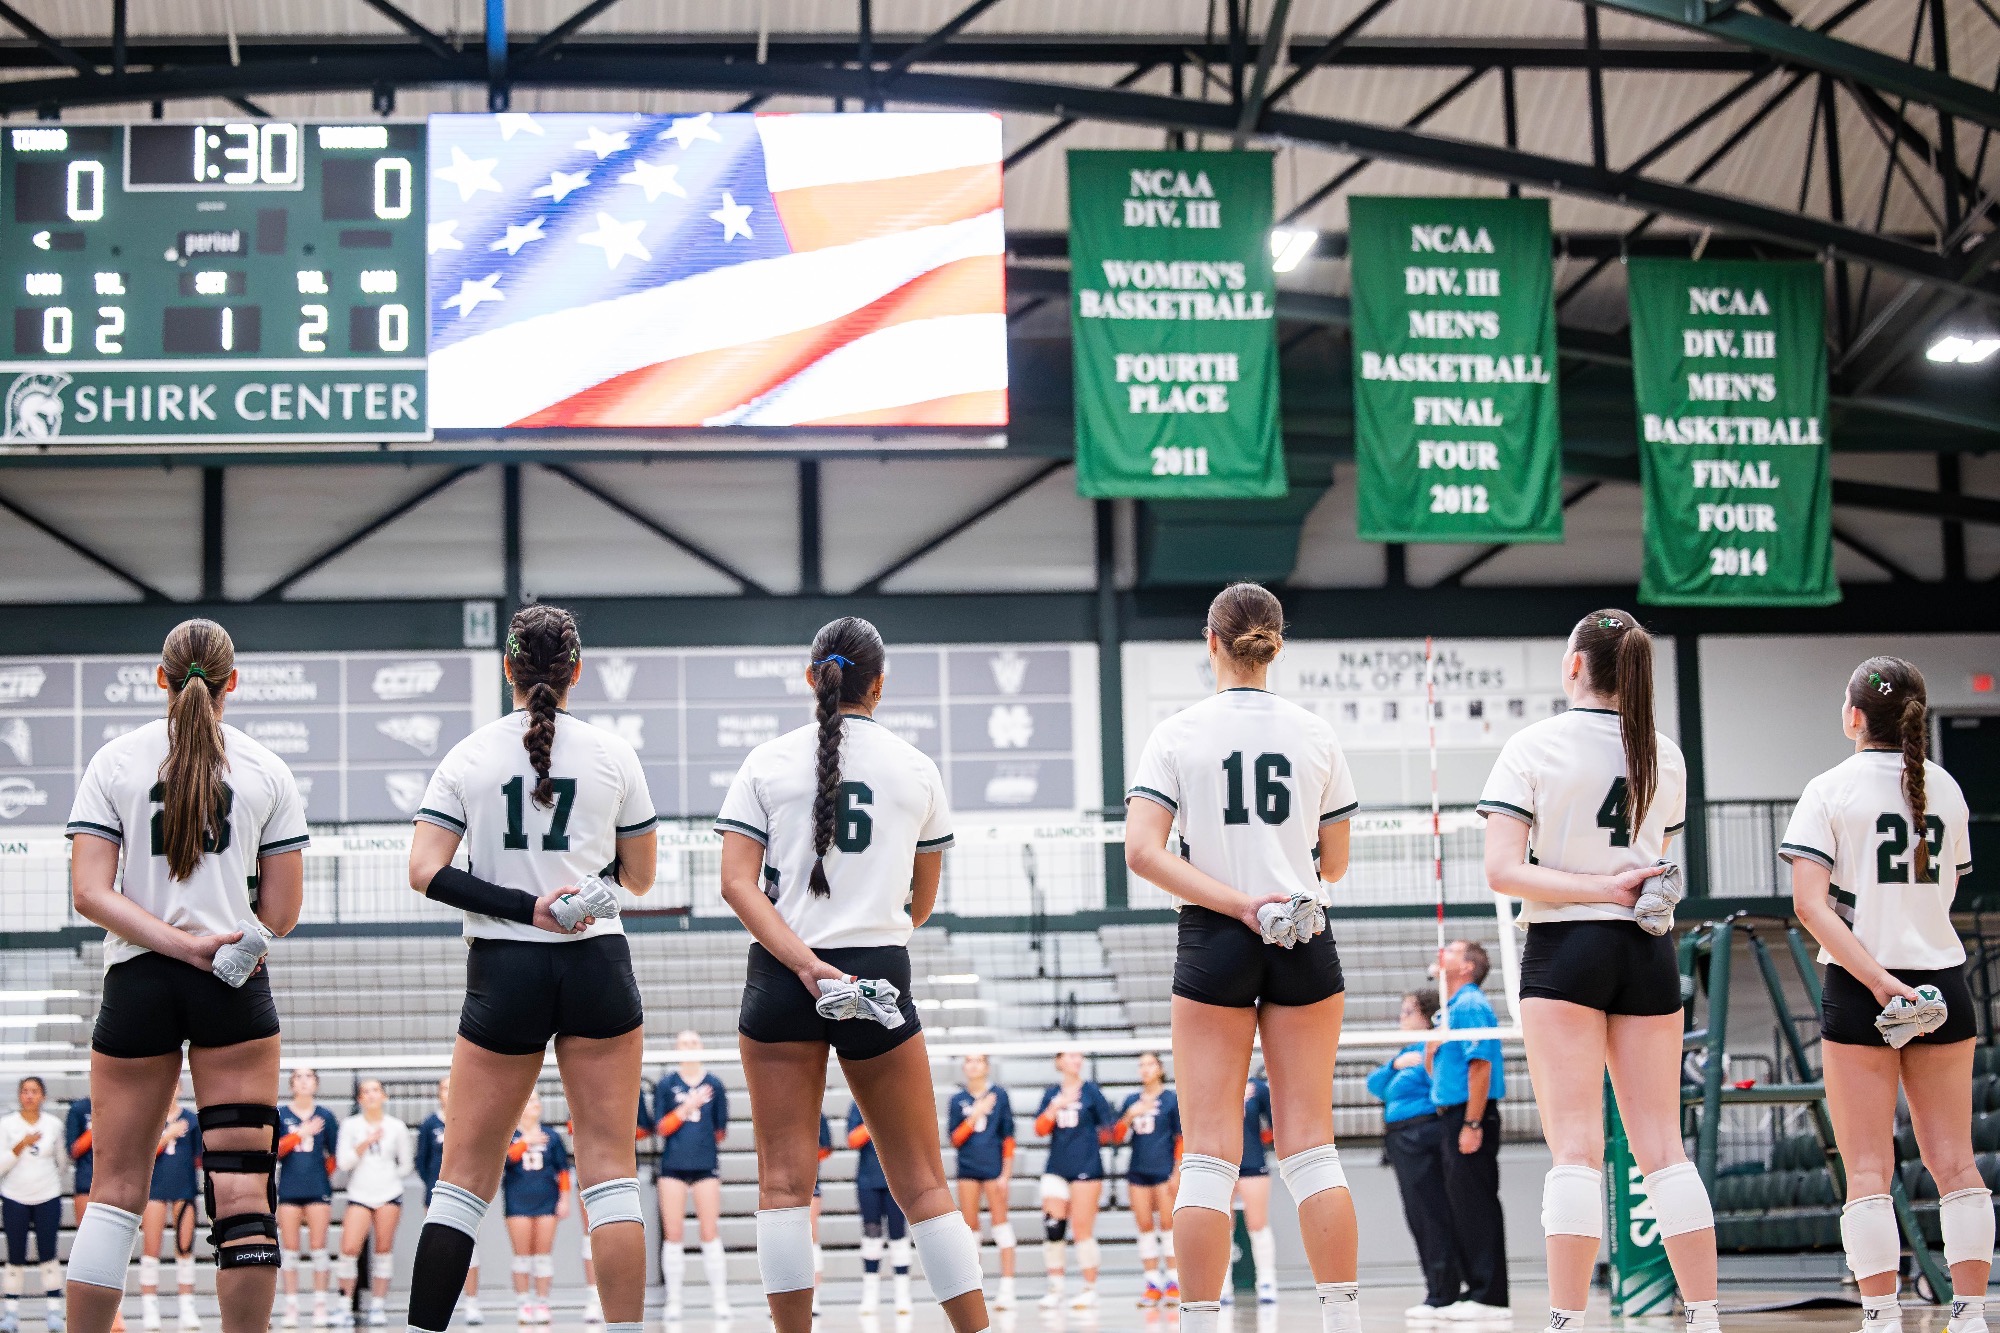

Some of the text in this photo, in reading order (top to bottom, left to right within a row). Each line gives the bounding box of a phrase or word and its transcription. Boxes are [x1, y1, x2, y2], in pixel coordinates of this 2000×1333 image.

[194, 123, 297, 184] 1:30
[67, 160, 104, 222] 0
[374, 157, 412, 220] 0
[1130, 170, 1214, 198] NCAA
[1123, 198, 1221, 229] DIV. III
[1411, 225, 1495, 254] NCAA
[1102, 260, 1247, 290] WOMEN'S
[1404, 267, 1500, 297] DIV. III
[1079, 290, 1274, 321] BASKETBALL
[1689, 287, 1770, 316] NCAA
[43, 307, 72, 354] 0
[95, 306, 126, 354] 2
[221, 307, 234, 351] 1
[298, 304, 329, 353] 2
[378, 304, 409, 352] 0
[1408, 310, 1501, 340] MEN'S
[1683, 330, 1776, 359] DIV. III
[1114, 353, 1240, 383] FOURTH
[1361, 352, 1551, 383] BASKETBALL
[1128, 384, 1230, 413] PLACE
[1688, 373, 1777, 402] MEN'S
[75, 383, 419, 423] SHIRK CENTER
[1412, 397, 1503, 427] FINAL
[1643, 413, 1822, 446] BASKETBALL
[1151, 446, 1209, 476] 2011
[1417, 440, 1500, 470] FOUR
[1691, 460, 1780, 489] FINAL
[1429, 484, 1490, 514] 2012
[1698, 503, 1778, 533] FOUR
[1709, 547, 1768, 577] 2014
[1339, 651, 1465, 670] NATIONAL
[1299, 668, 1505, 692] HALL OF FAMERS
[1222, 750, 1293, 826] 16
[501, 774, 578, 852] 17
[834, 779, 874, 855] 6
[1596, 775, 1633, 849] 4
[342, 839, 406, 852] ILLINOIS
[1876, 811, 1946, 886] 22
